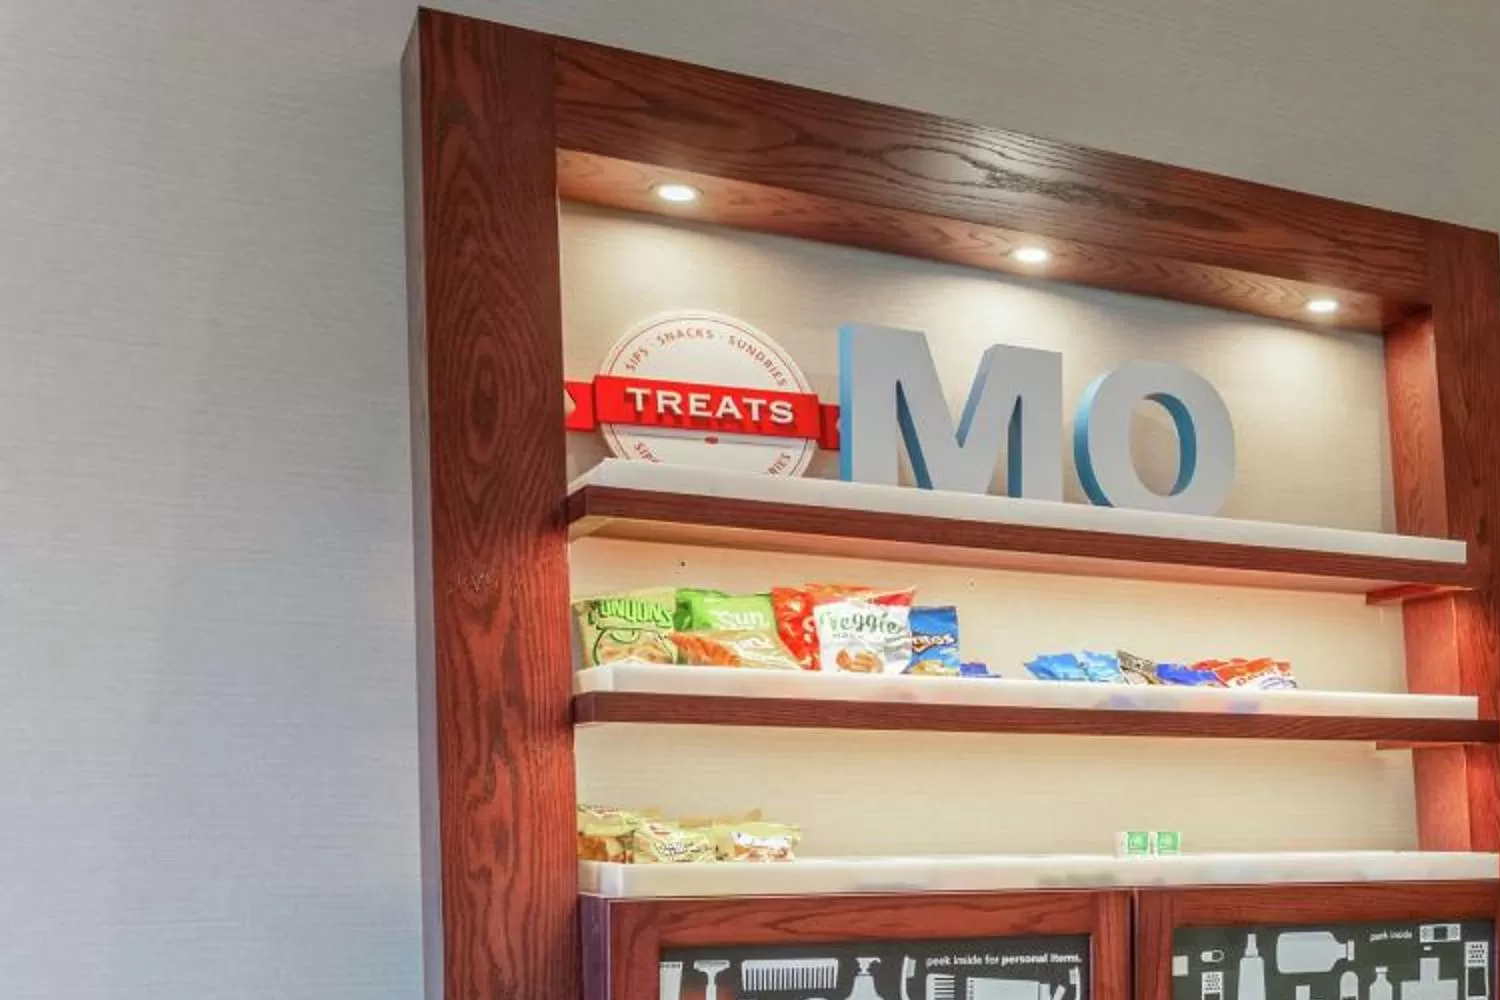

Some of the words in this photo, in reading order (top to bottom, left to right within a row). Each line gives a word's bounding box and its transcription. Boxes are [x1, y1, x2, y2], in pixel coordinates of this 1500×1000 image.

[625, 348, 649, 371] SIPS
[657, 326, 715, 345] SNACKS
[728, 335, 788, 388] SUNDRIES
[625, 387, 795, 425] TREATS
[840, 324, 1236, 517] MO
[925, 954, 951, 968] peek
[953, 954, 982, 966] inside
[985, 954, 999, 965] for
[1001, 953, 1048, 967] personal
